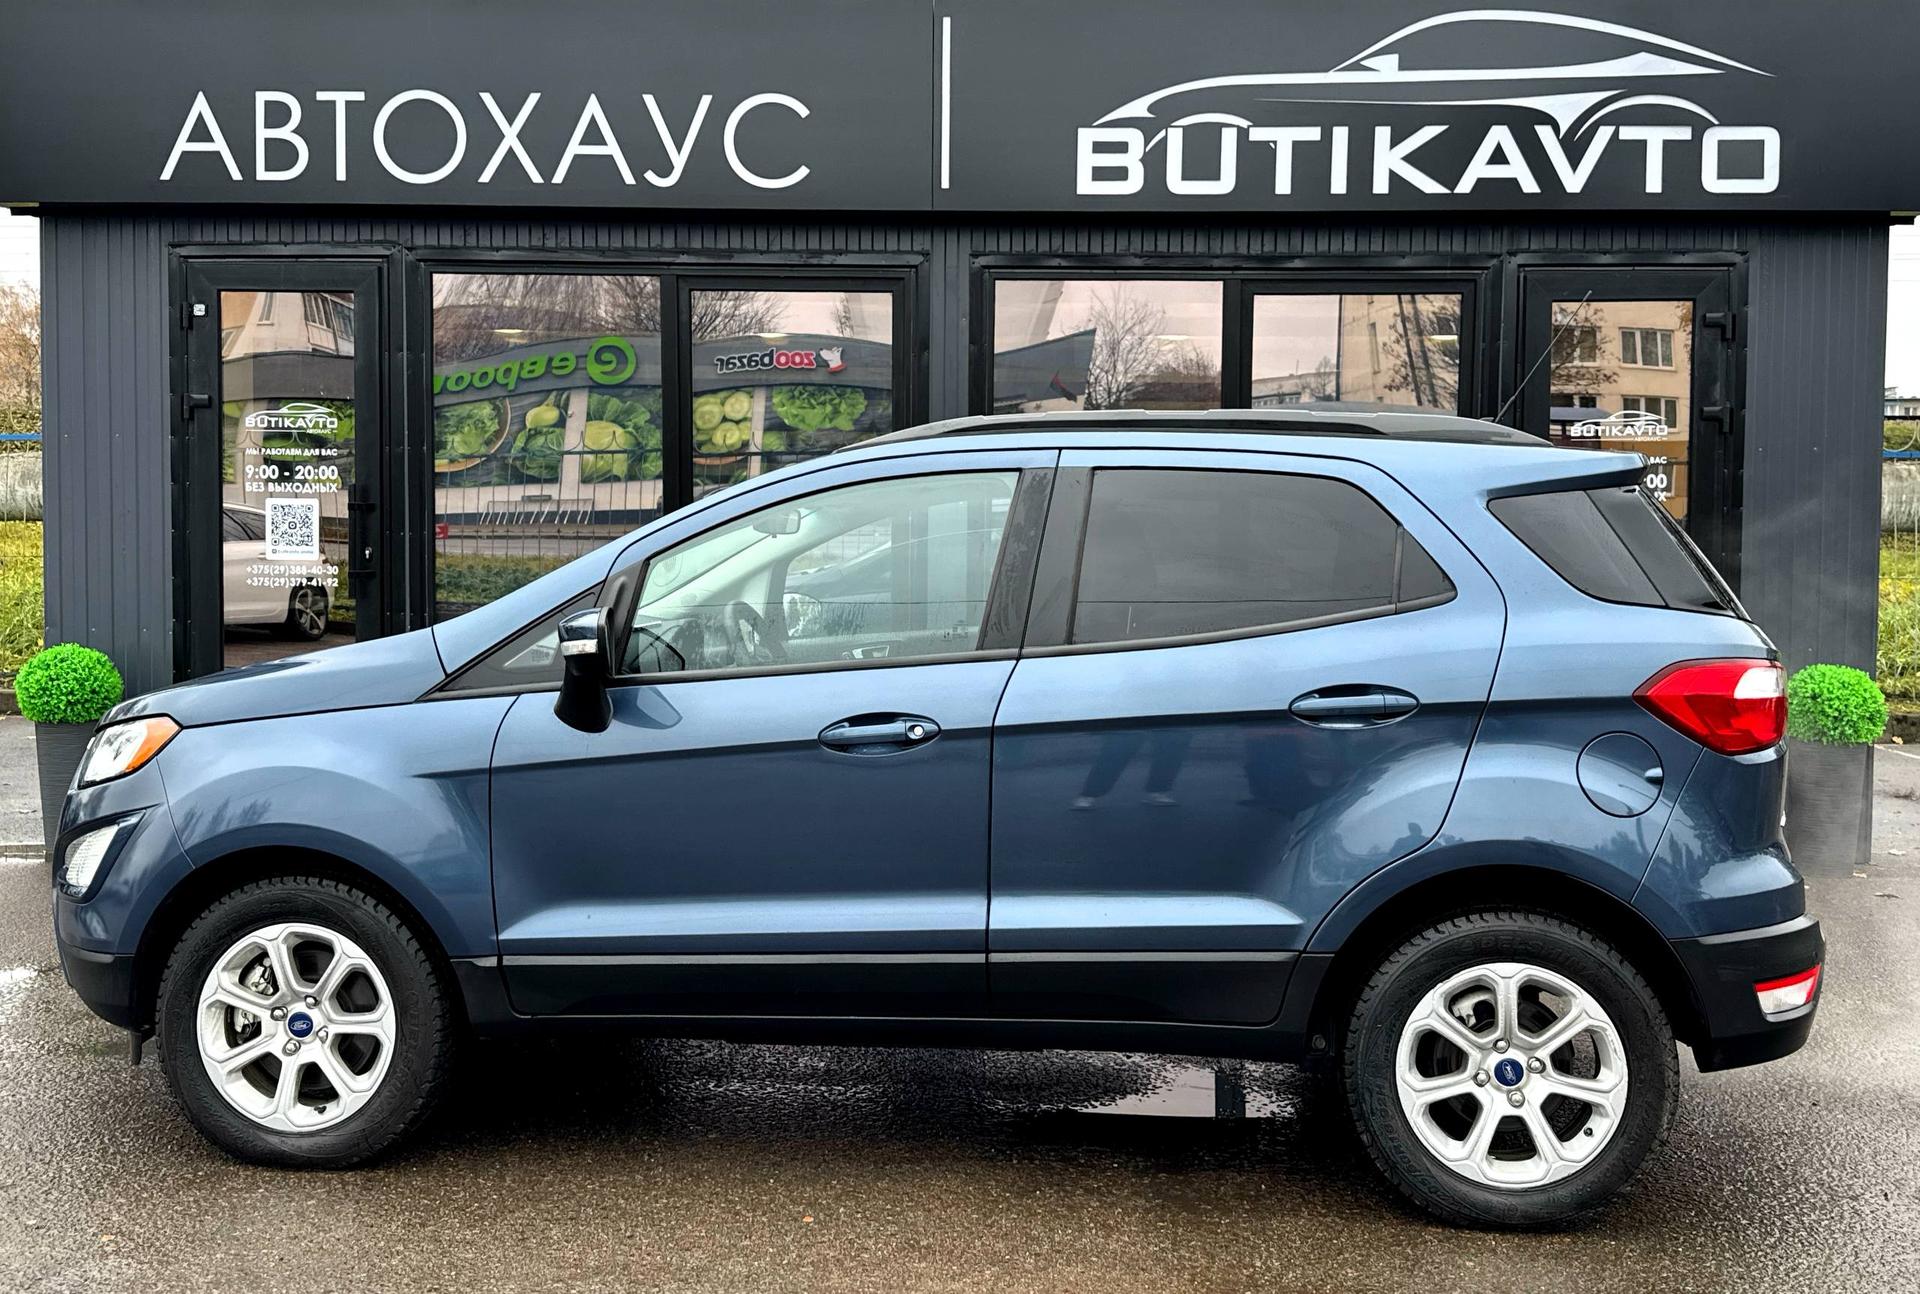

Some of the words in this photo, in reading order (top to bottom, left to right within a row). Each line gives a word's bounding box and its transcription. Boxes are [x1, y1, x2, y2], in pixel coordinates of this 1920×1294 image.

[160, 89, 811, 189] АВТОХАУС
[1075, 124, 1781, 196] BUTIKAVTO
[245, 416, 338, 428] BUTIKAVTO
[1570, 425, 1668, 437] BUTIKAVTO
[245, 448, 260, 456] МЫ
[262, 448, 302, 456] РАБОТАЕМ
[303, 448, 320, 456] ДЛЯ
[321, 448, 338, 456] ВАС
[245, 464, 280, 480] 9:00
[294, 465, 339, 480] 20:00
[245, 482, 265, 493] БЕЗ
[268, 482, 338, 494] ВЫХОДНЫХ
